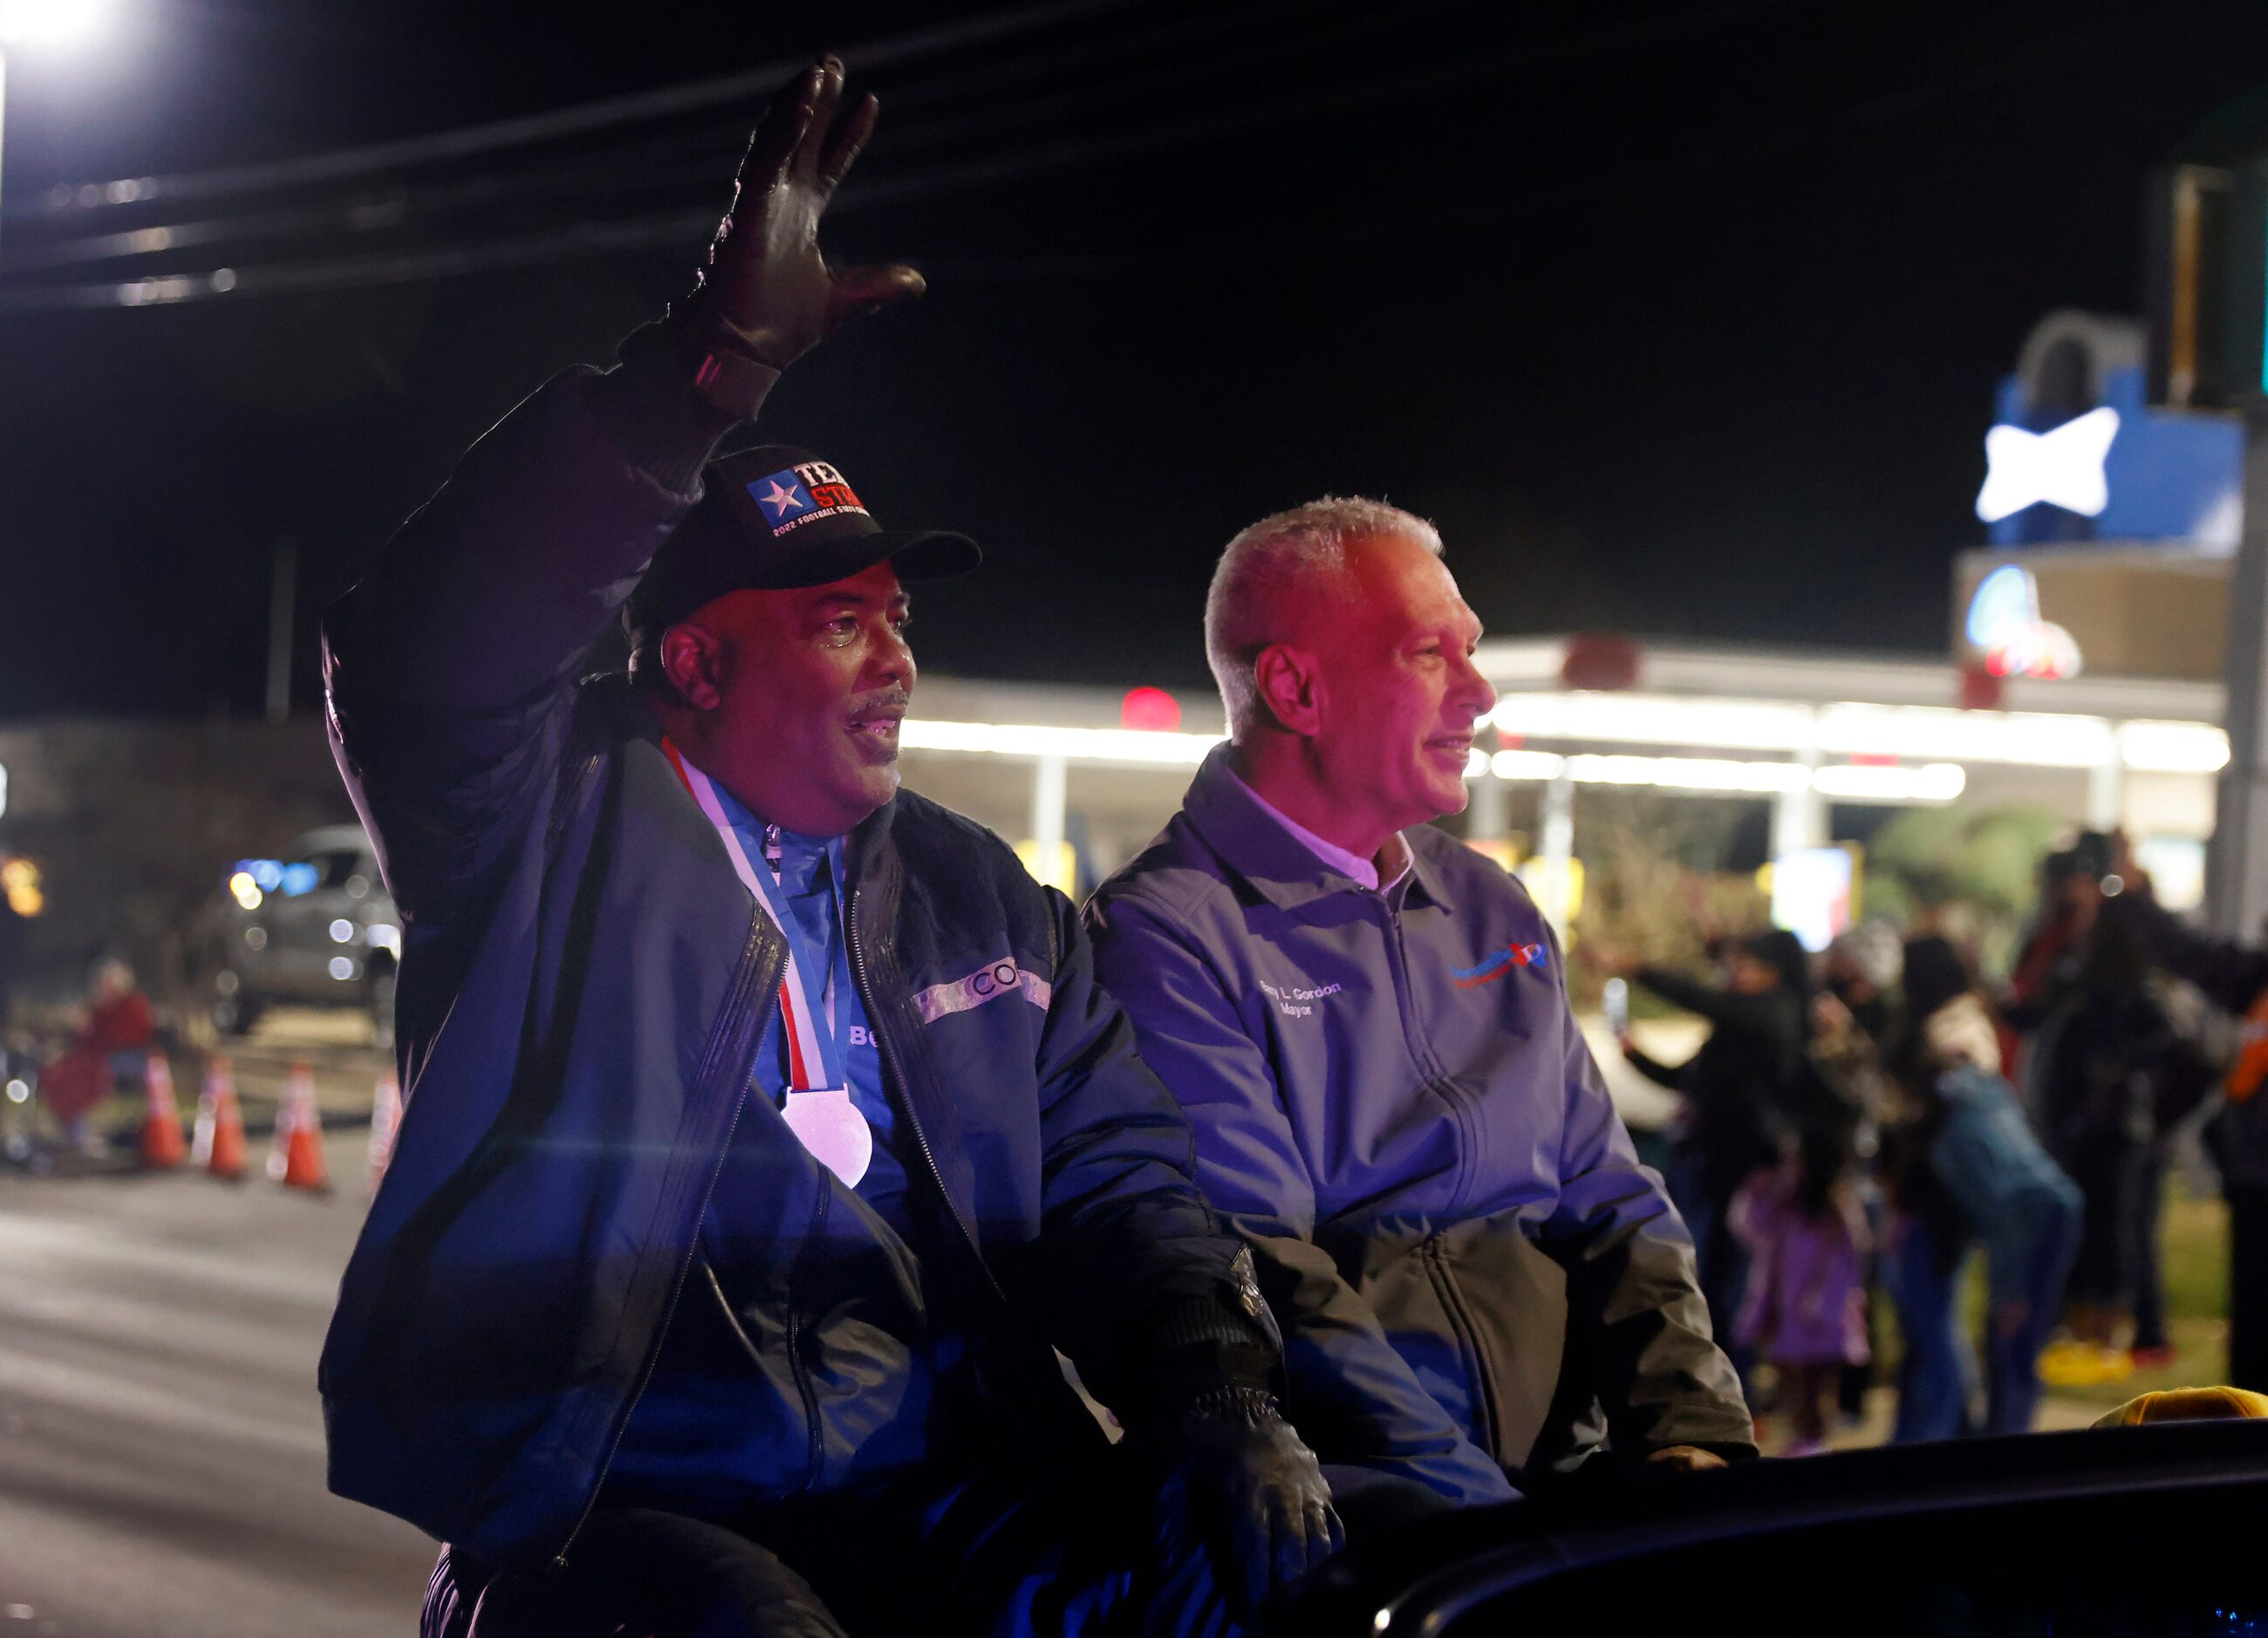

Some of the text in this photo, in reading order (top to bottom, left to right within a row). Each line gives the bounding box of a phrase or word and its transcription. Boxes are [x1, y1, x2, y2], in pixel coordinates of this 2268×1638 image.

[773, 521, 797, 538] 2022
[797, 508, 837, 526] FOOTBALL
[1293, 982, 1342, 1000] Gordon
[1280, 1002, 1312, 1018] Mayor
